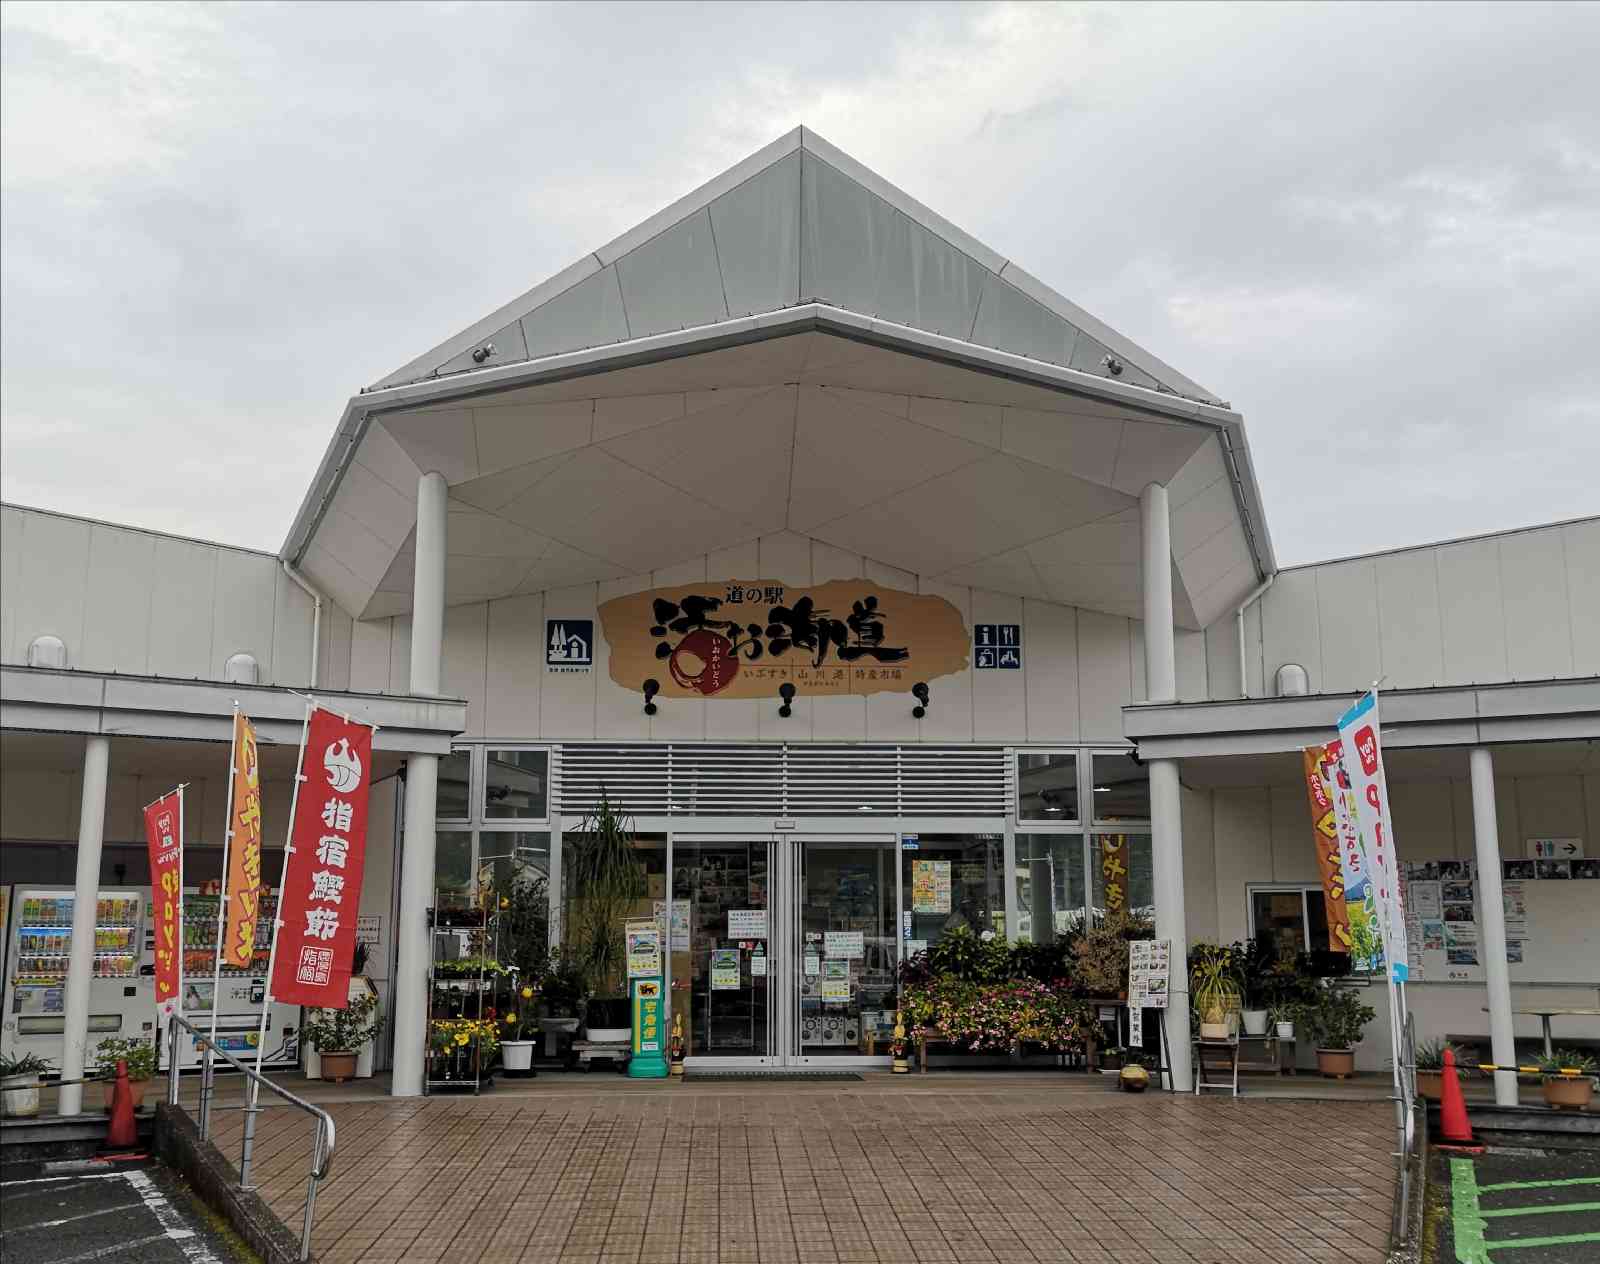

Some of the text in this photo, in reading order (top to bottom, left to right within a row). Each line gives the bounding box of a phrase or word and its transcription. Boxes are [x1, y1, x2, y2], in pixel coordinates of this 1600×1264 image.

[725, 586, 784, 604] 道の駅
[711, 637, 721, 687] いおかいどう
[743, 669, 903, 680] いぶすき 山川港 特産市場
[304, 797, 354, 941] 指宿鰹節
